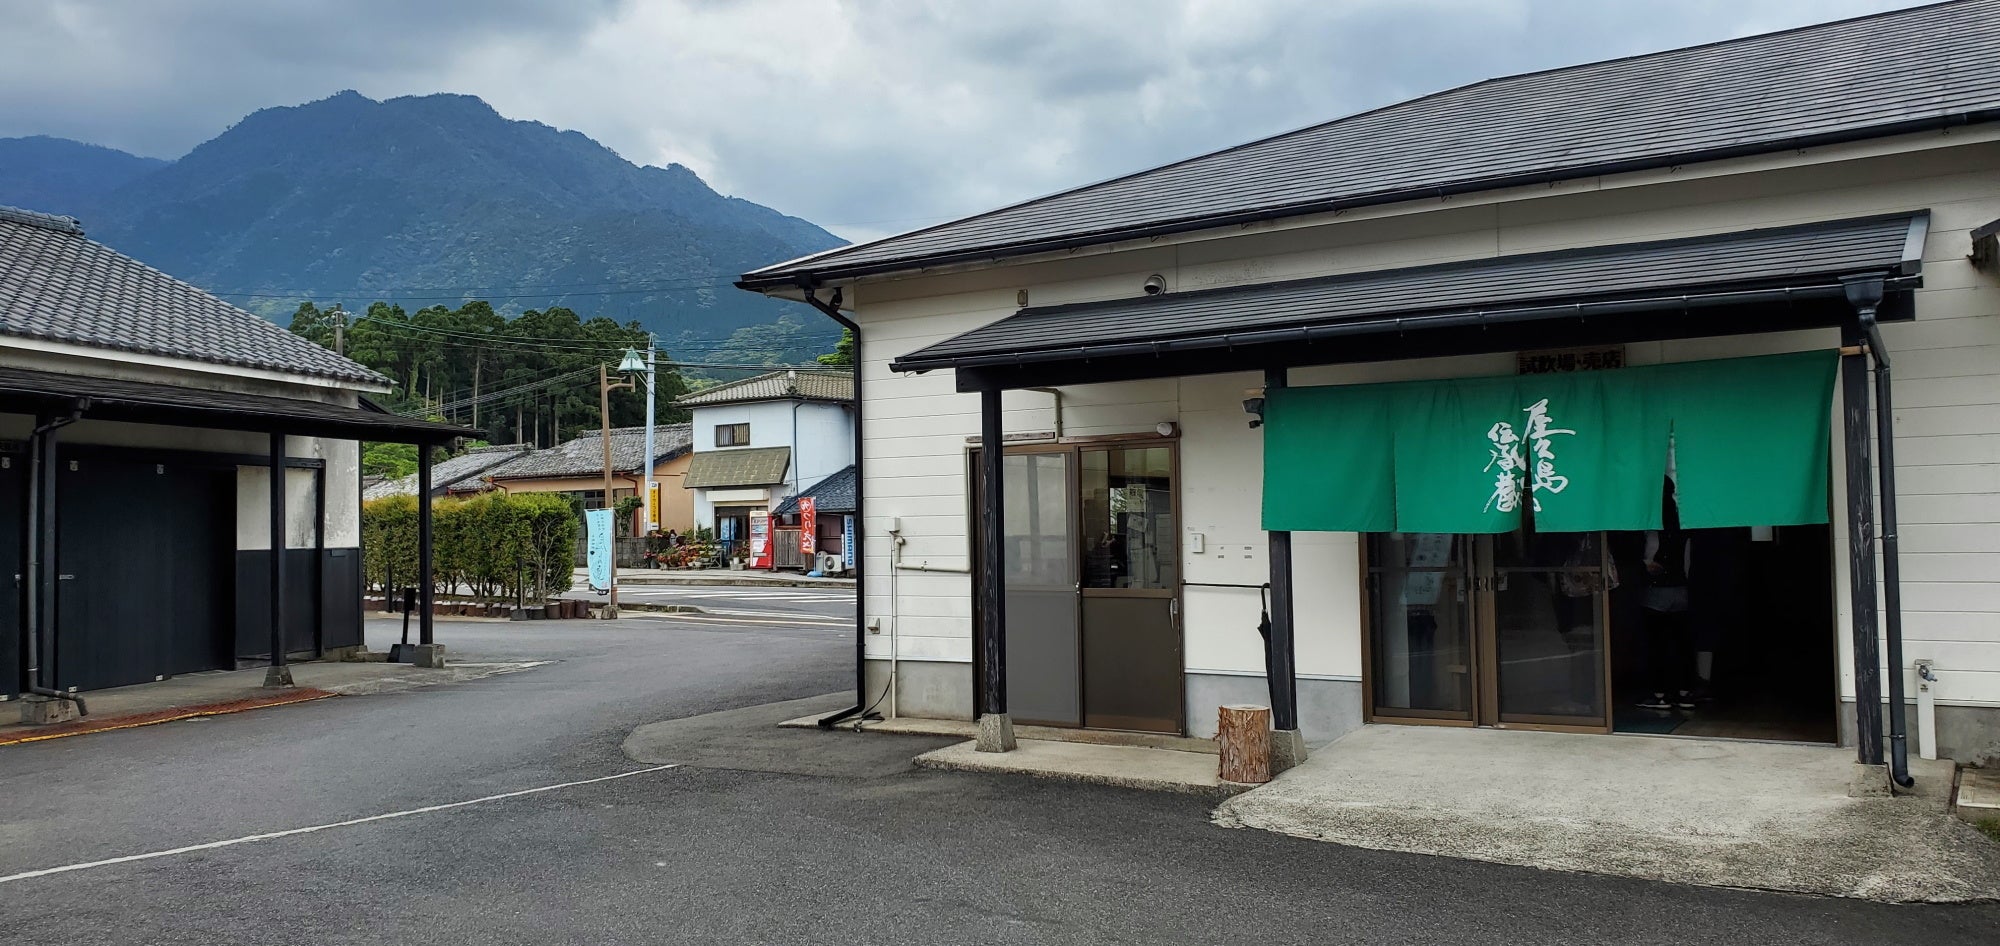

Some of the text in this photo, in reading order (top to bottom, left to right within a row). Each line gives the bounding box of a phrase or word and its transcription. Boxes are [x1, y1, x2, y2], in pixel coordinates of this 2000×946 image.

[1522, 398, 1576, 493] 屋久島
[846, 518, 854, 566] SHIMANO
